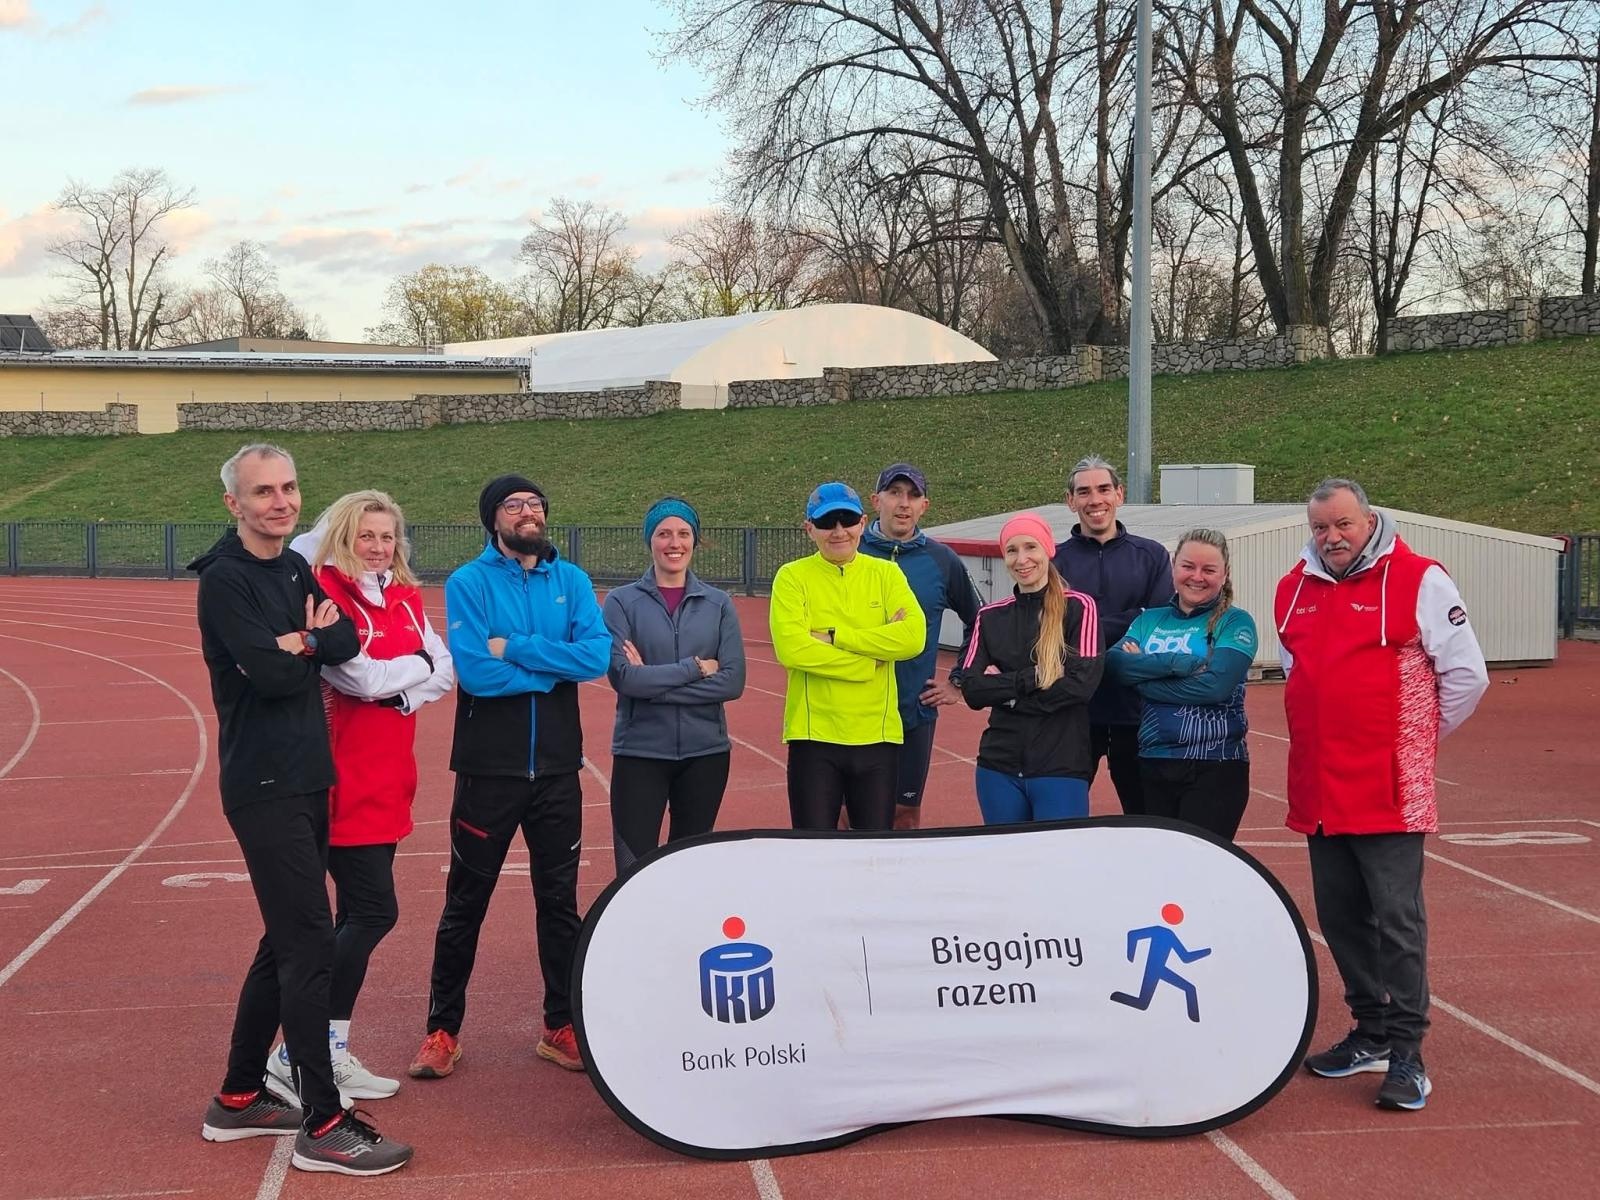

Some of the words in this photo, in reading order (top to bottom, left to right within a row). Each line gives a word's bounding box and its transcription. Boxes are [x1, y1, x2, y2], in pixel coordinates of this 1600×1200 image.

[931, 931, 1084, 971] Biegajmy
[699, 942, 776, 1024] PKO
[937, 982, 1037, 1008] razem
[682, 1047, 737, 1072] Bank
[745, 1042, 806, 1067] Polski
